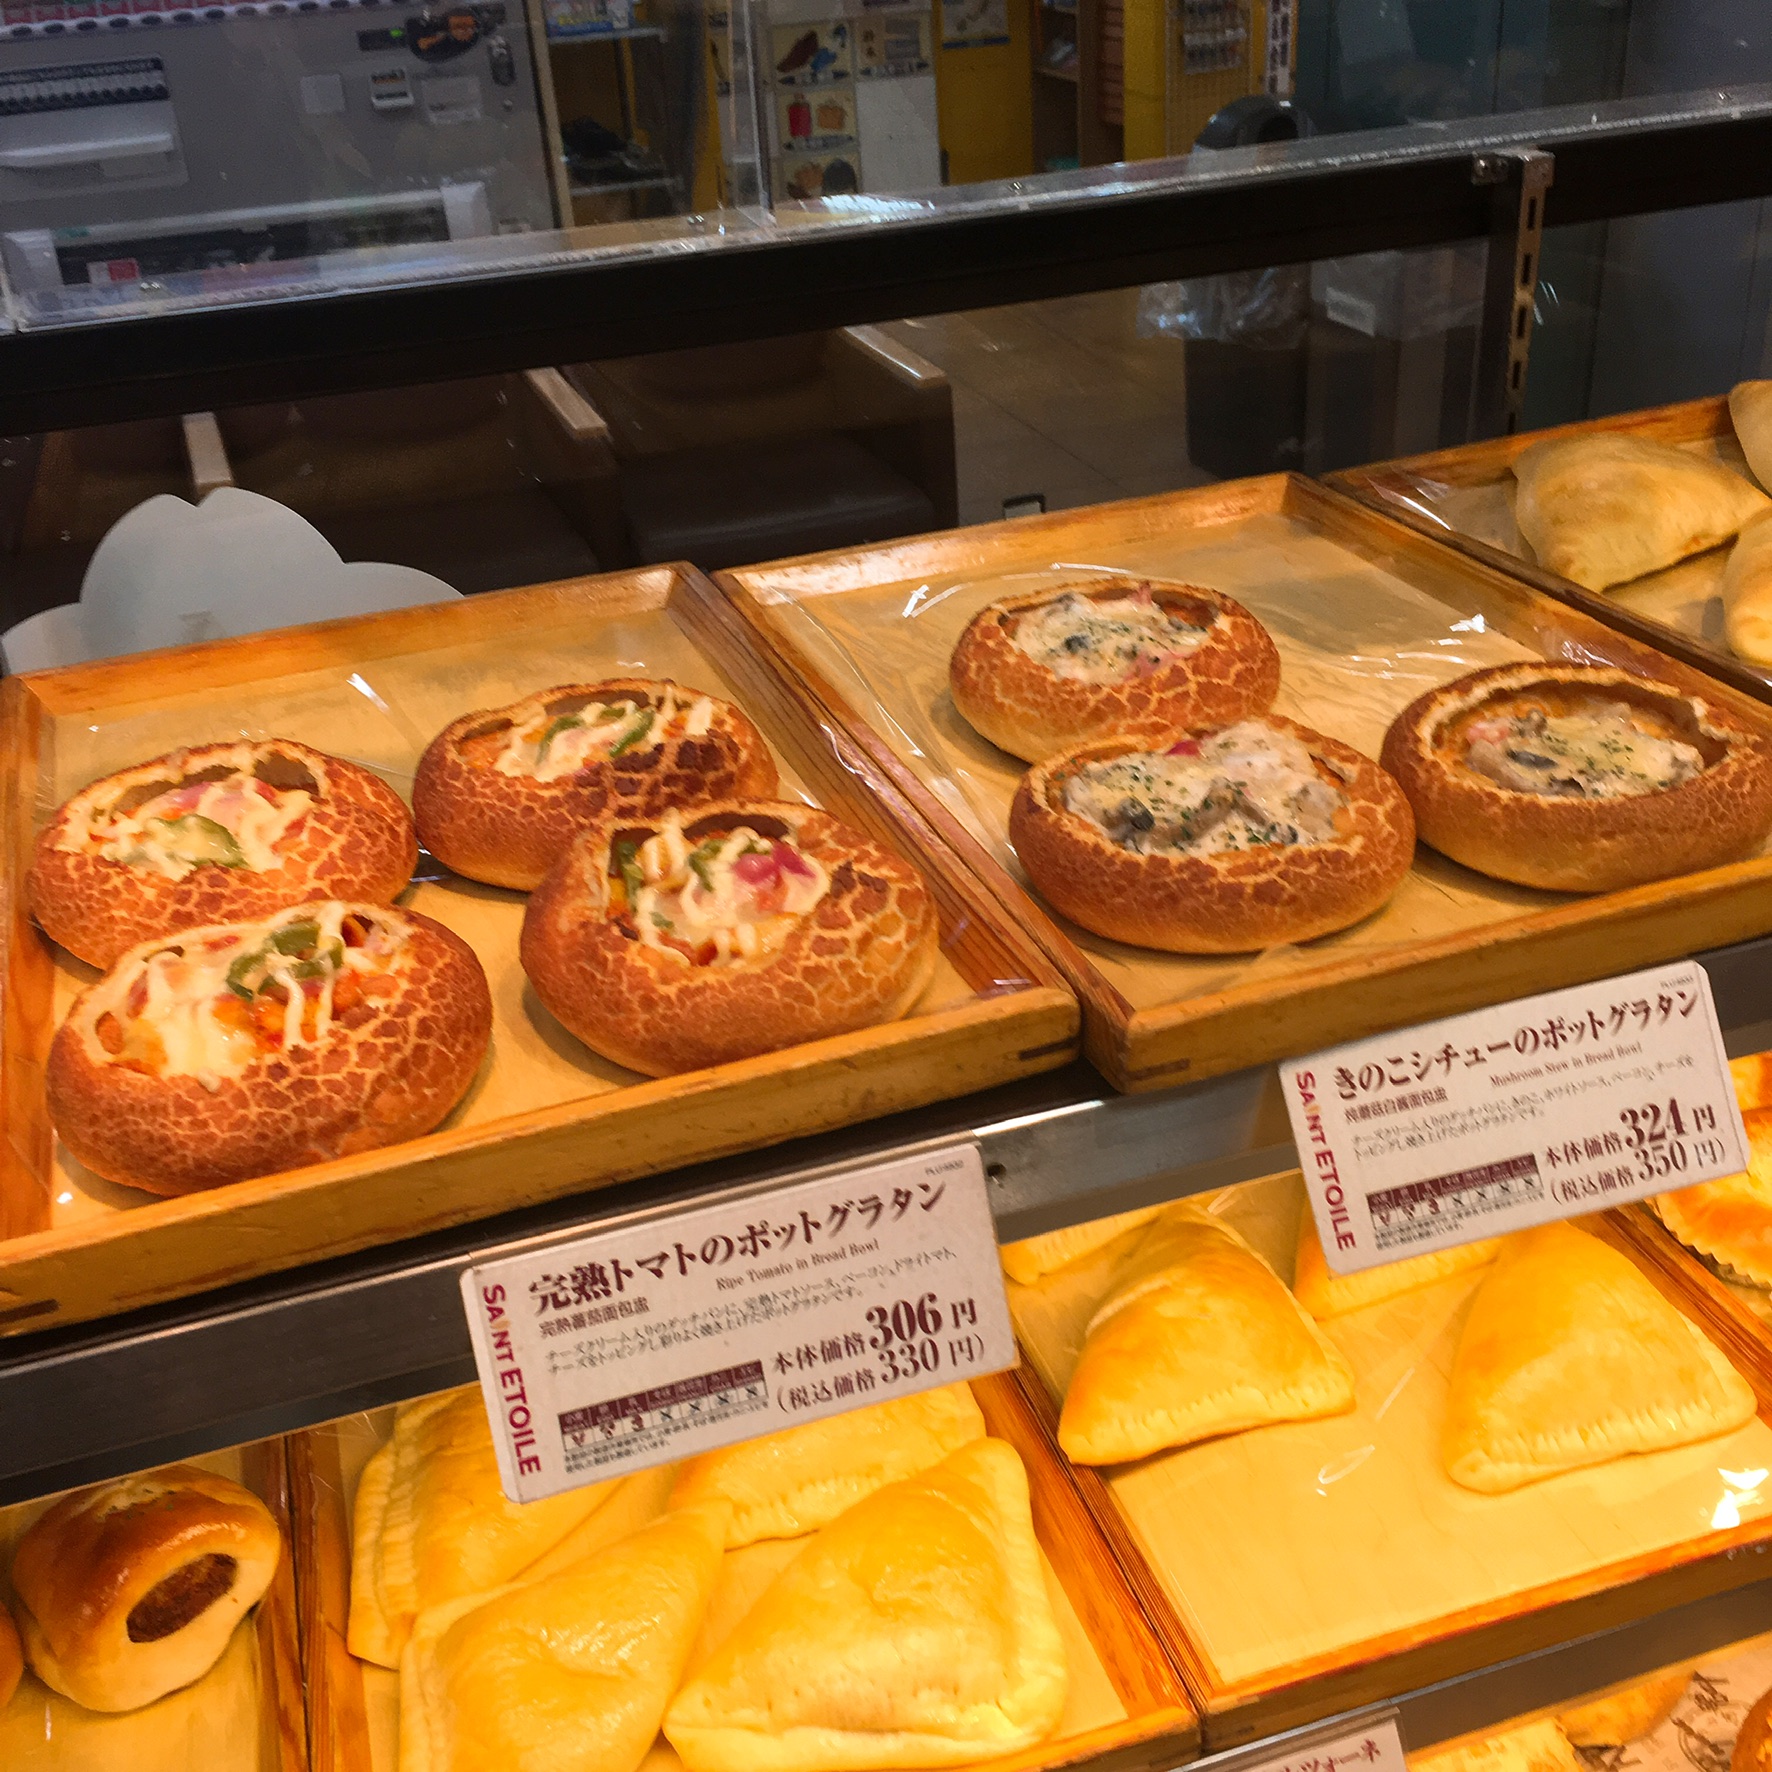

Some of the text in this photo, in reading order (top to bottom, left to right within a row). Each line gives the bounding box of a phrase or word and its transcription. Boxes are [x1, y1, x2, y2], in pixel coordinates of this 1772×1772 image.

[1333, 977, 1698, 1101] きのこシチューのポットグラタン
[1489, 1041, 1643, 1089] Mushroom Stew in Bread Bowl
[1296, 1071, 1356, 1251] SAINT ETOILE
[528, 1182, 946, 1317] 完熟トマトのポットグラタン
[715, 1239, 881, 1292] Ripe Tomato in Bread Bowl
[482, 1284, 541, 1477] SAINT ETOILE
